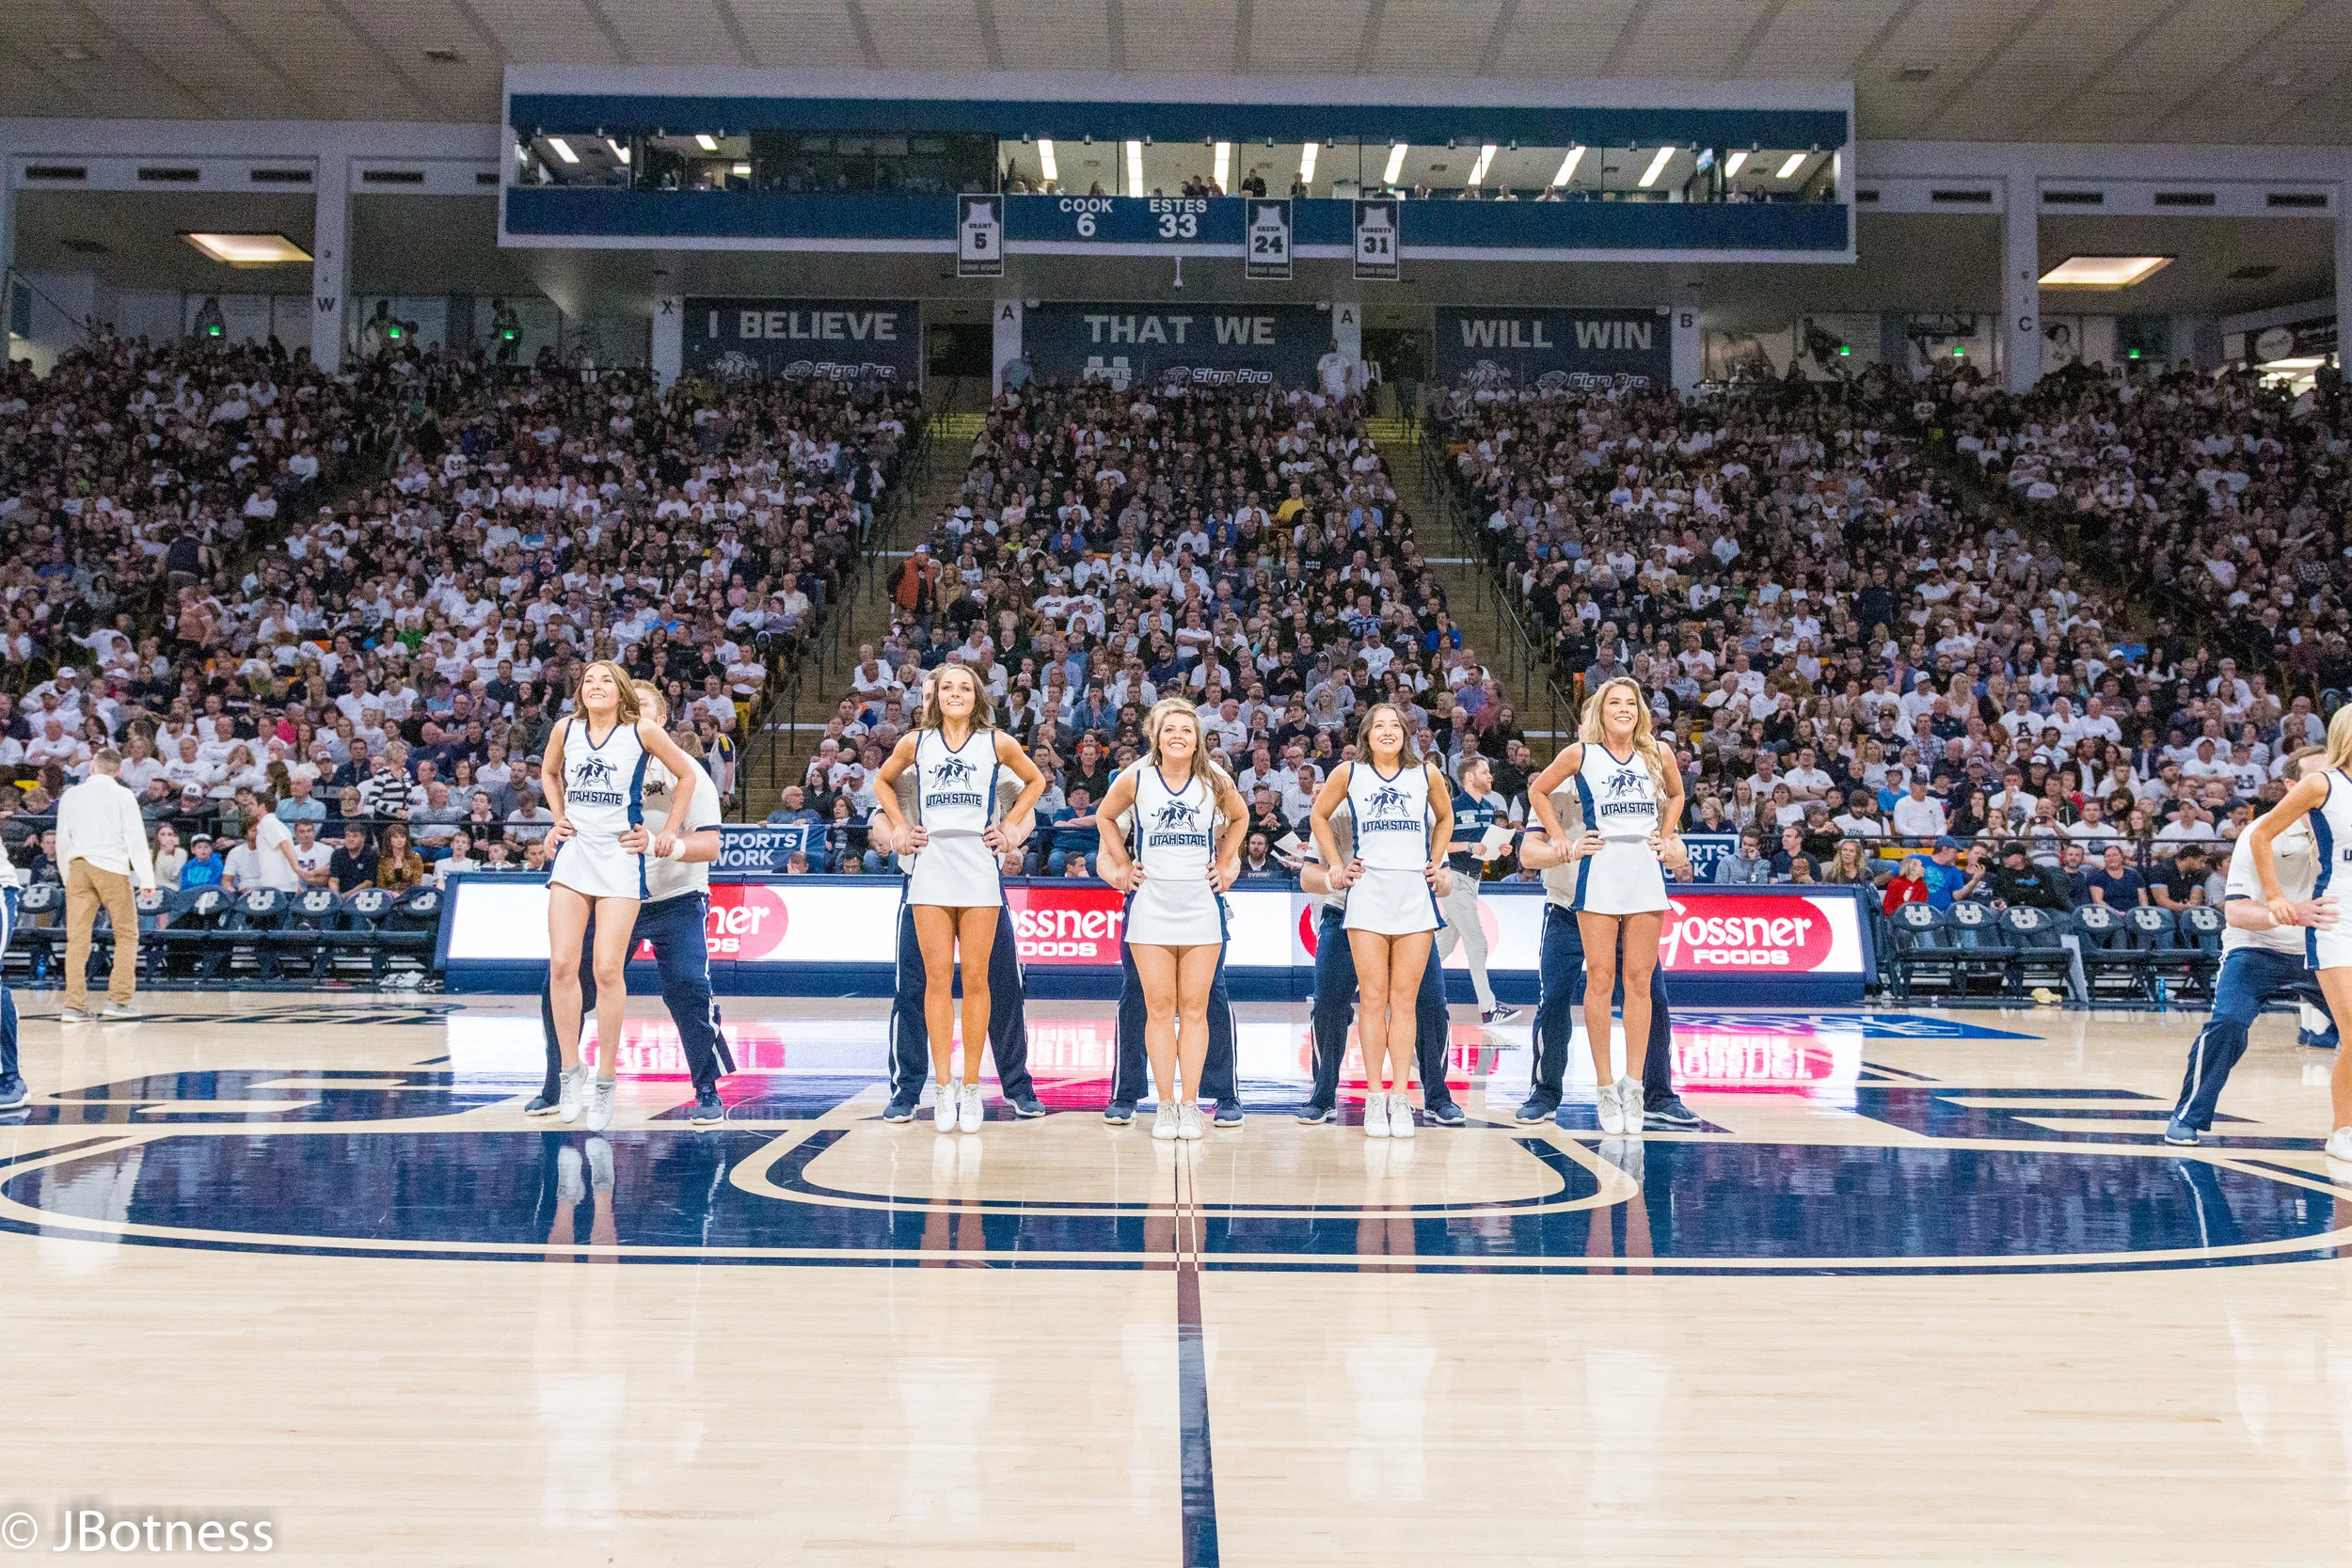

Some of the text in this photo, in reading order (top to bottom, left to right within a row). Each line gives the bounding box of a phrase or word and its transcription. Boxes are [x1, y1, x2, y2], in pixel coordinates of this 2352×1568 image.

[1059, 198, 1113, 213] COOK
[1149, 198, 1207, 213] ESTES
[1076, 213, 1096, 236] 6
[1158, 214, 1198, 238] 33
[975, 232, 987, 249] 5
[1254, 235, 1284, 254] 24
[1363, 236, 1390, 254] 31
[317, 296, 336, 312] W
[661, 300, 674, 315] X
[1001, 304, 1015, 320] A
[1341, 309, 1354, 325] A
[1679, 313, 1693, 328] B
[2018, 315, 2033, 332] C
[708, 310, 898, 341] I BELIEVE
[1084, 314, 1276, 345] THAT WE
[1460, 319, 1653, 350] WILL WIN
[860, 363, 896, 377] Pro
[1236, 368, 1274, 384] Pro
[566, 788, 624, 807] UTAH STATE
[926, 792, 983, 808] UTAH STATE
[1601, 801, 1655, 817] UTAH STATE
[1362, 819, 1422, 834] UTAH STATE
[1148, 832, 1208, 848] UTAH STATE
[1688, 844, 1730, 861] RTS
[1009, 909, 1123, 940] ssner
[1660, 898, 1813, 967] Gossner
[1016, 942, 1098, 958] OODS
[1692, 949, 1790, 965] FOODS
